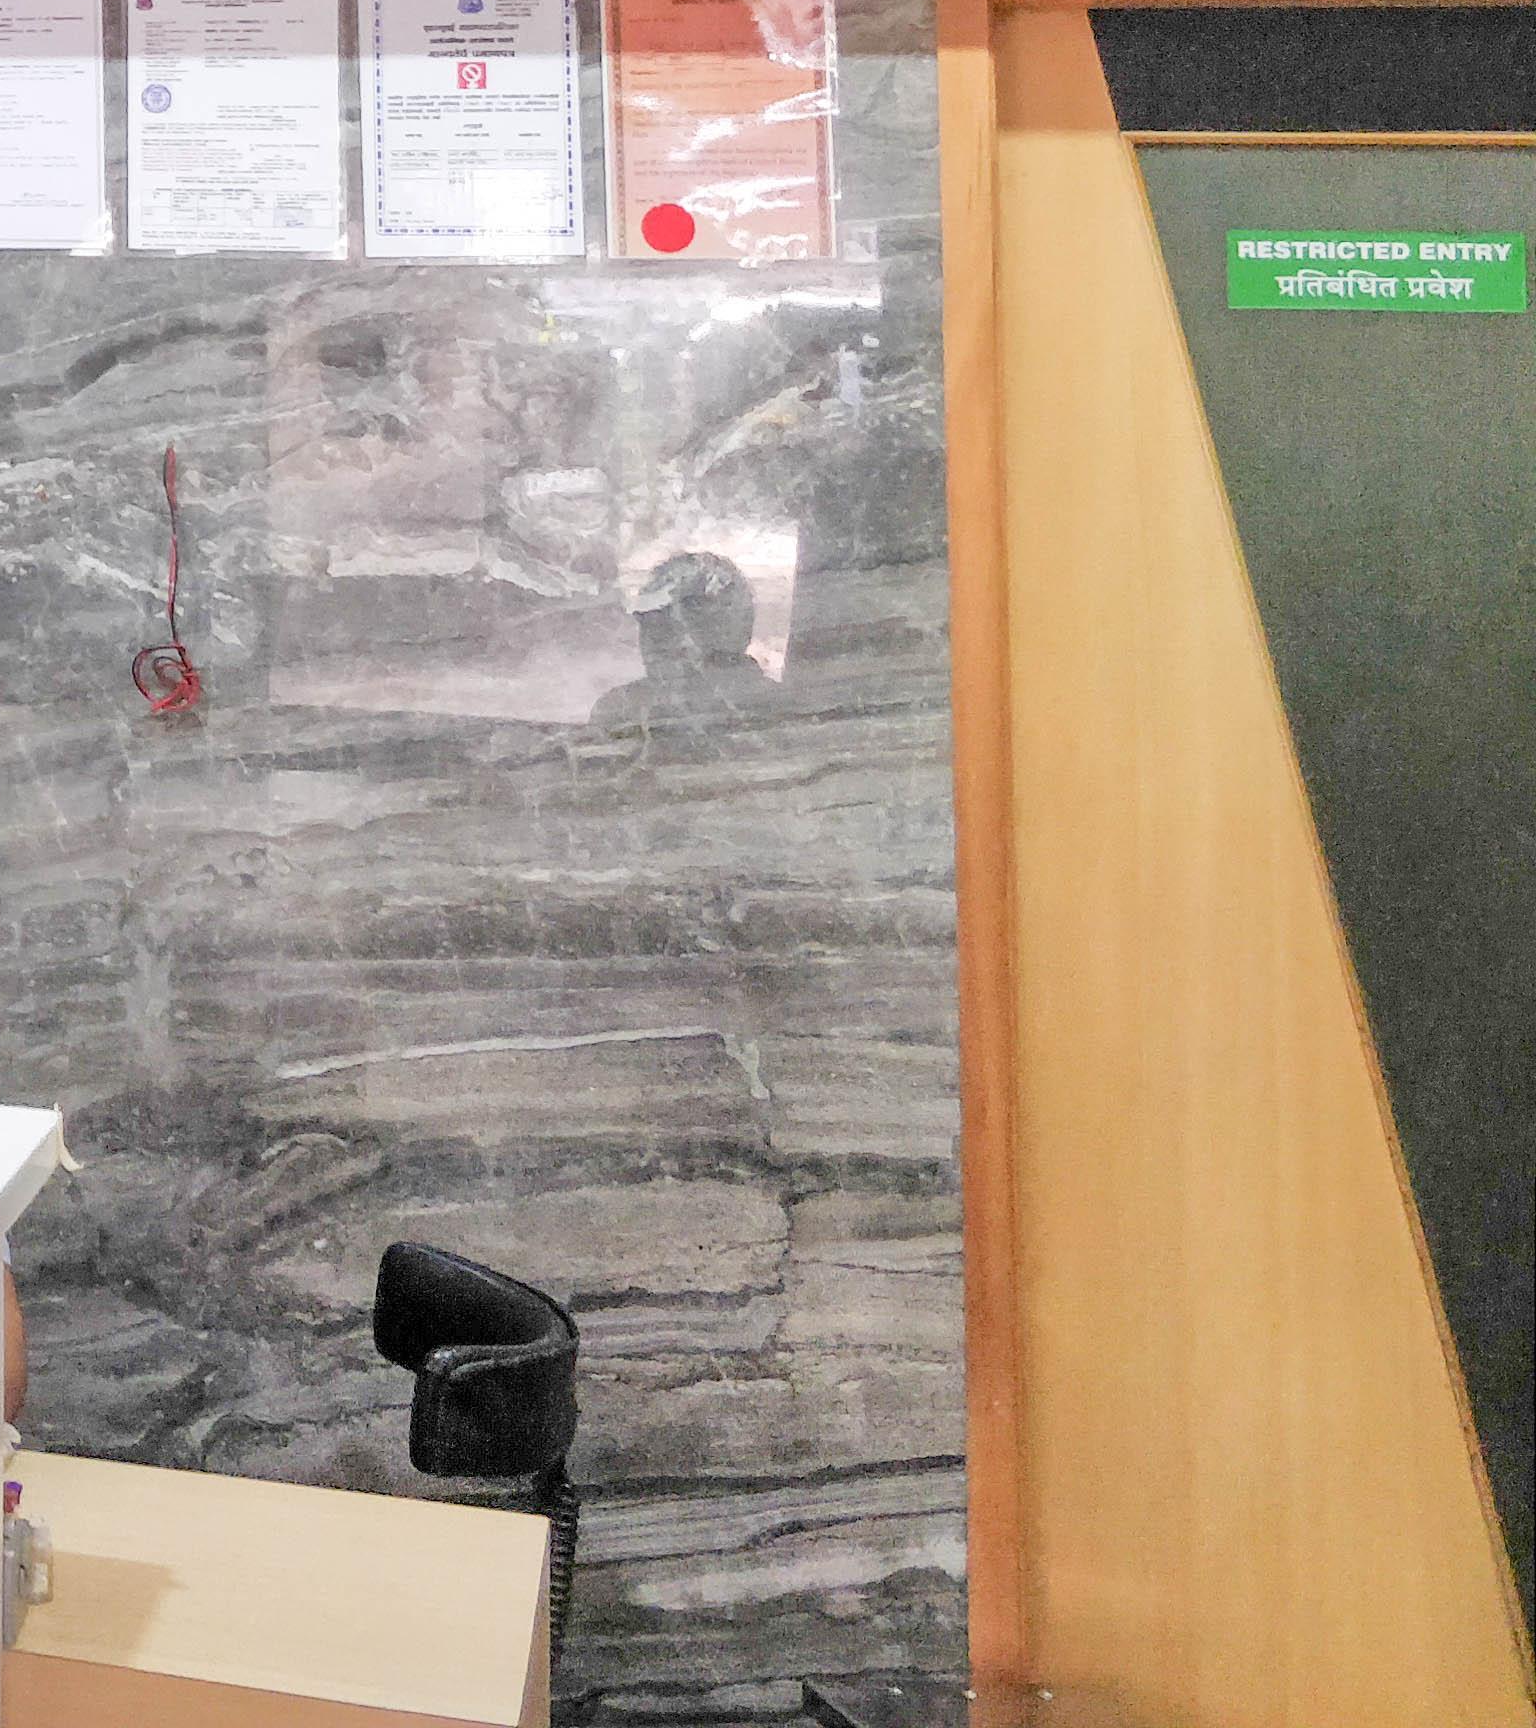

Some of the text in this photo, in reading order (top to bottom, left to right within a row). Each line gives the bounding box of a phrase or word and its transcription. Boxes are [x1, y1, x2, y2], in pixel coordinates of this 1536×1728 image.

[1237, 240, 1512, 262] RESTRICTED ENTRY
[1274, 268, 1474, 301] प्रतिबंधित प्रवेश
